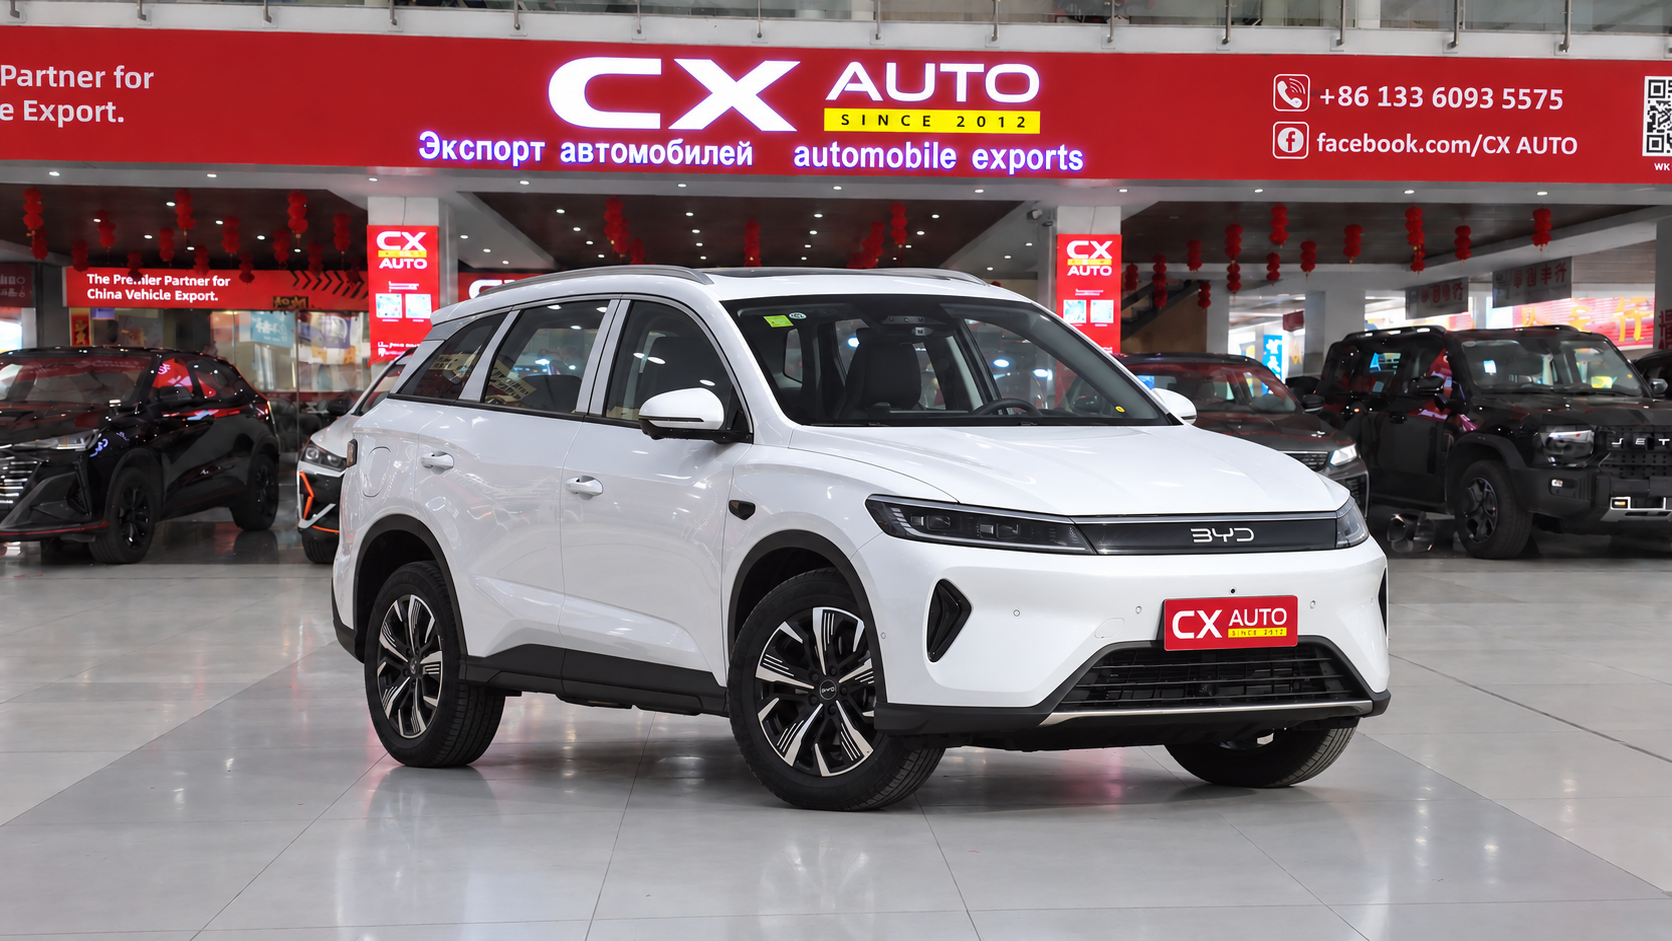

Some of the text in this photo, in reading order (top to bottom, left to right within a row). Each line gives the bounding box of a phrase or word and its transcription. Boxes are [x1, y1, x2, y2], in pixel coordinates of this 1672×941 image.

[1, 65, 155, 89] Partner for
[548, 57, 1040, 132] CX AUTO
[1319, 85, 1563, 110] +86 133 6093 5575
[24, 100, 124, 128] Export.
[841, 114, 1026, 128] SINCE 2012
[418, 131, 753, 167] Экспорт автомобилей
[1316, 132, 1578, 158] facebook.com/CX AUTO
[794, 141, 1084, 175] automobile exports
[376, 230, 427, 251] CX
[1066, 240, 1113, 259] CX
[379, 258, 428, 269] AUTO
[1067, 265, 1113, 276] AUTO
[87, 273, 110, 285] The
[164, 275, 210, 287] Partner
[212, 275, 231, 287] for
[469, 279, 516, 299] C
[87, 288, 219, 304] China Vehicle Export.
[1190, 527, 1255, 543] BYD
[1172, 608, 1288, 639] CX AUTO
